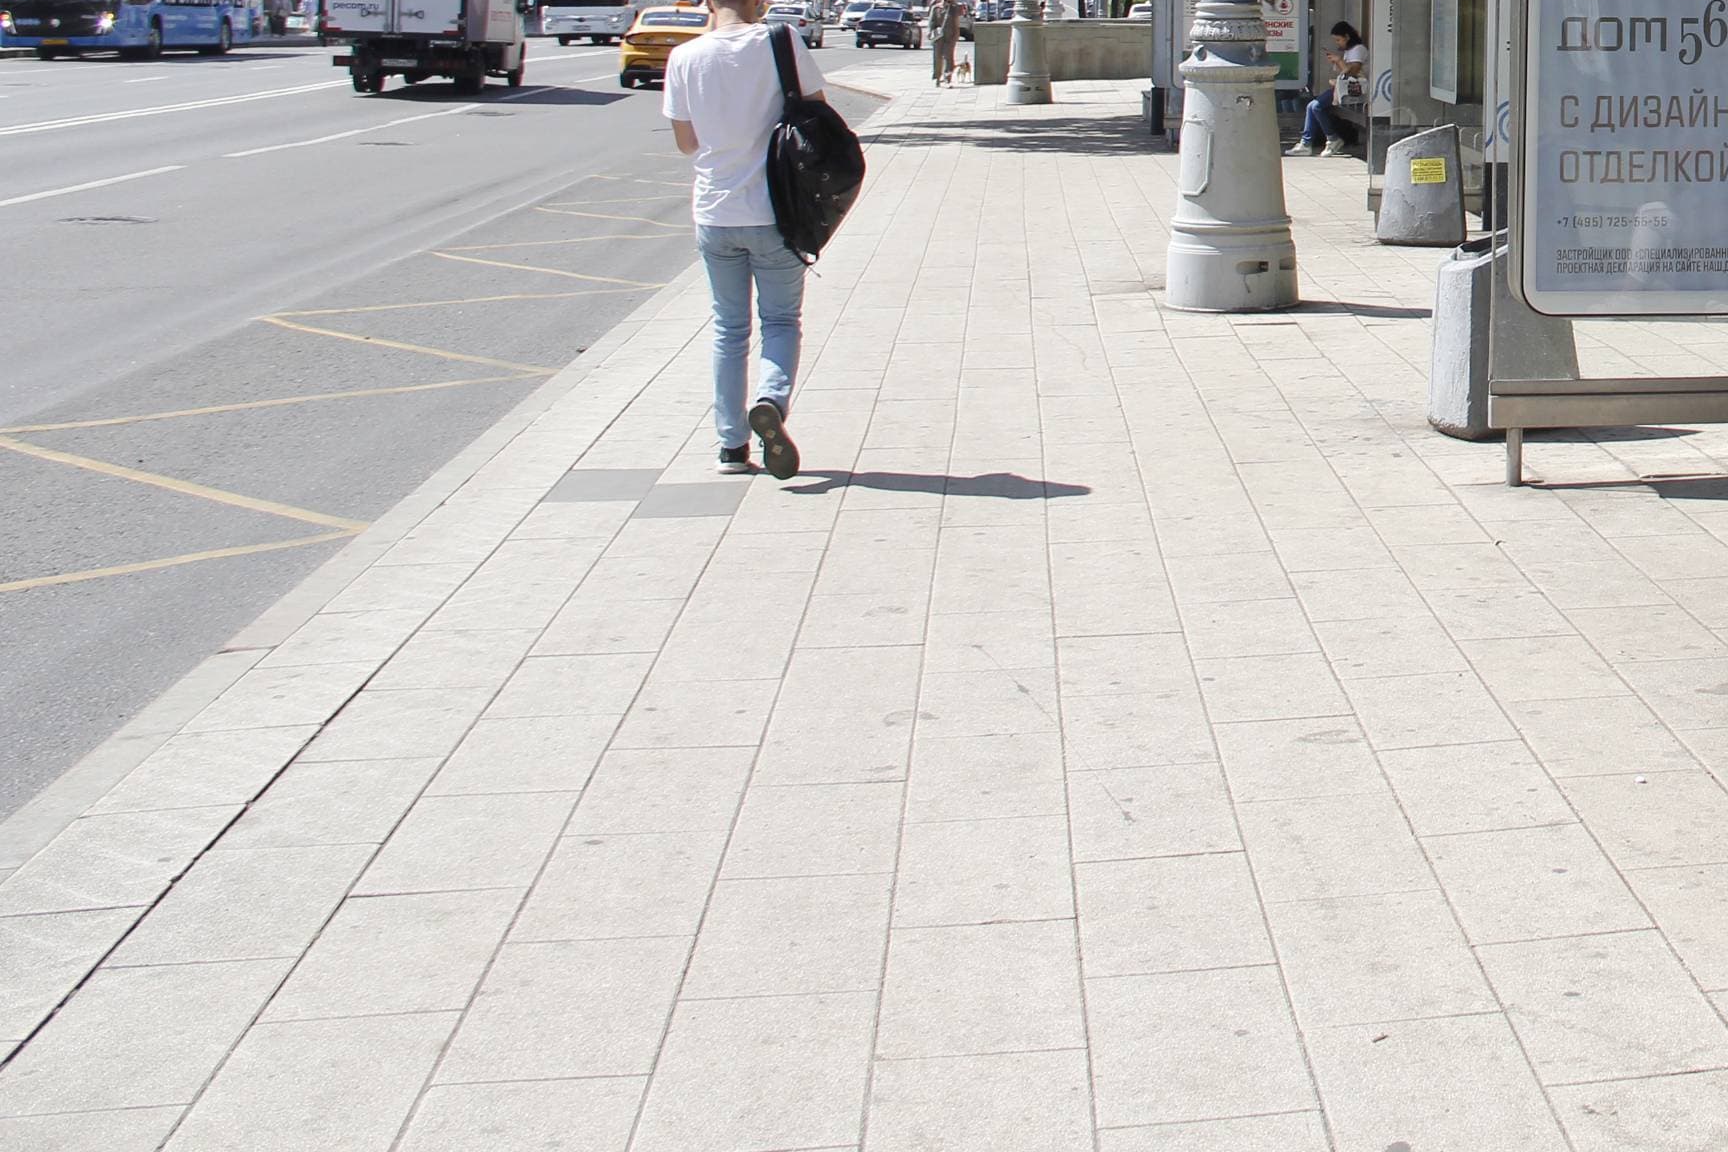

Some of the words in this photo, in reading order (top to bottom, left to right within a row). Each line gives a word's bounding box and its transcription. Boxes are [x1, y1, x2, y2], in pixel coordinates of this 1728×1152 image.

[333, 1, 379, 12] pecom.ru
[1678, 0, 1728, 65] 56
[1560, 95, 1579, 128] С
[1556, 247, 1613, 261] ЗАСТРОЙЩИК
[1556, 261, 1604, 274] ПРОЕКТНАЯ
[1605, 260, 1661, 275] ДЕКЛАРАЦИЯ
[1662, 260, 1674, 272] НА
[1675, 259, 1701, 272] САЙТЕ
